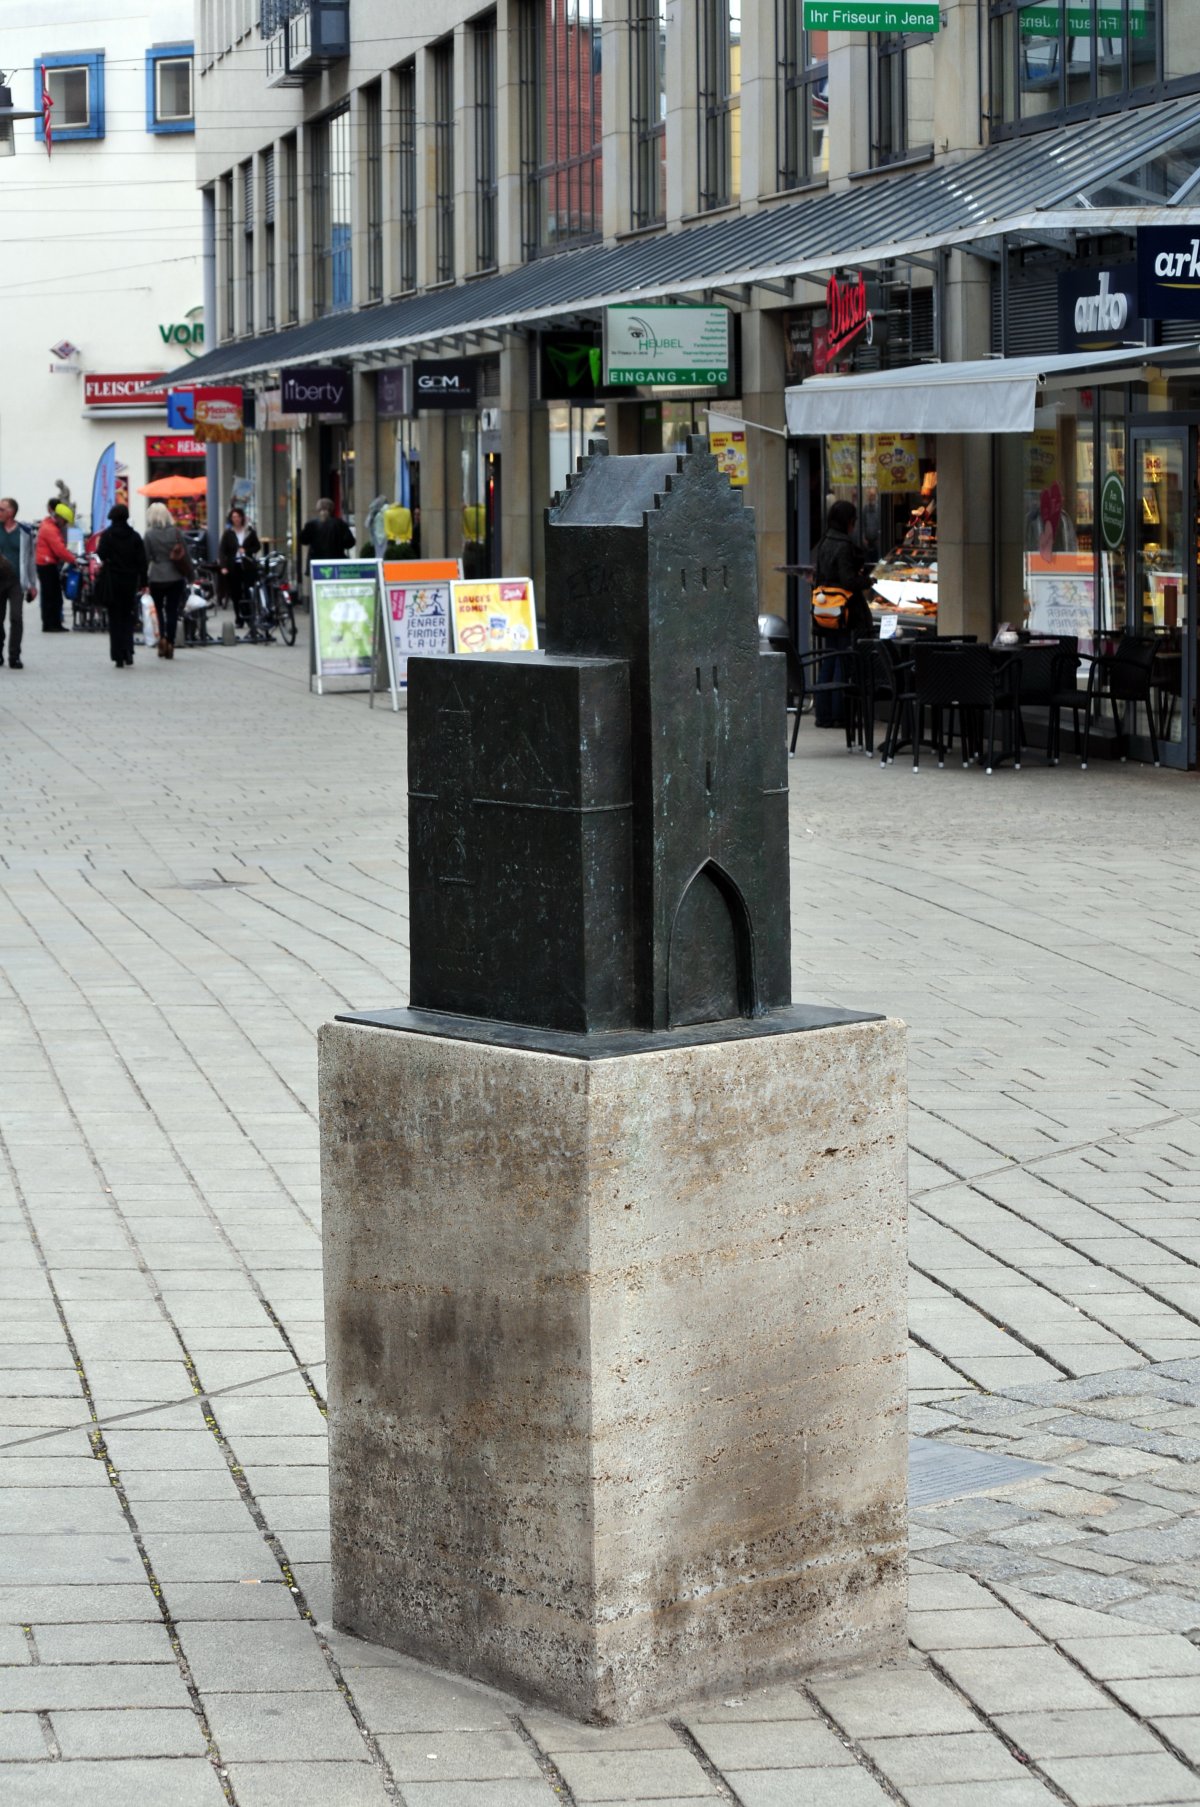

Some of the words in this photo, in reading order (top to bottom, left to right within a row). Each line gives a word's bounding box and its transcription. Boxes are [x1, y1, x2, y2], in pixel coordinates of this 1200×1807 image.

[810, 10, 829, 23] Ihr
[832, 10, 881, 24] Friseur
[885, 11, 897, 24] in
[901, 12, 934, 25] Jena
[826, 271, 867, 344] Ditsch
[1075, 271, 1128, 333] arko
[639, 338, 683, 351] HEUBEL
[610, 371, 677, 383] EINGANG
[707, 371, 728, 383] OG
[284, 379, 343, 404] liberty
[407, 617, 446, 629] JENAER
[407, 628, 447, 639] FIRMEN
